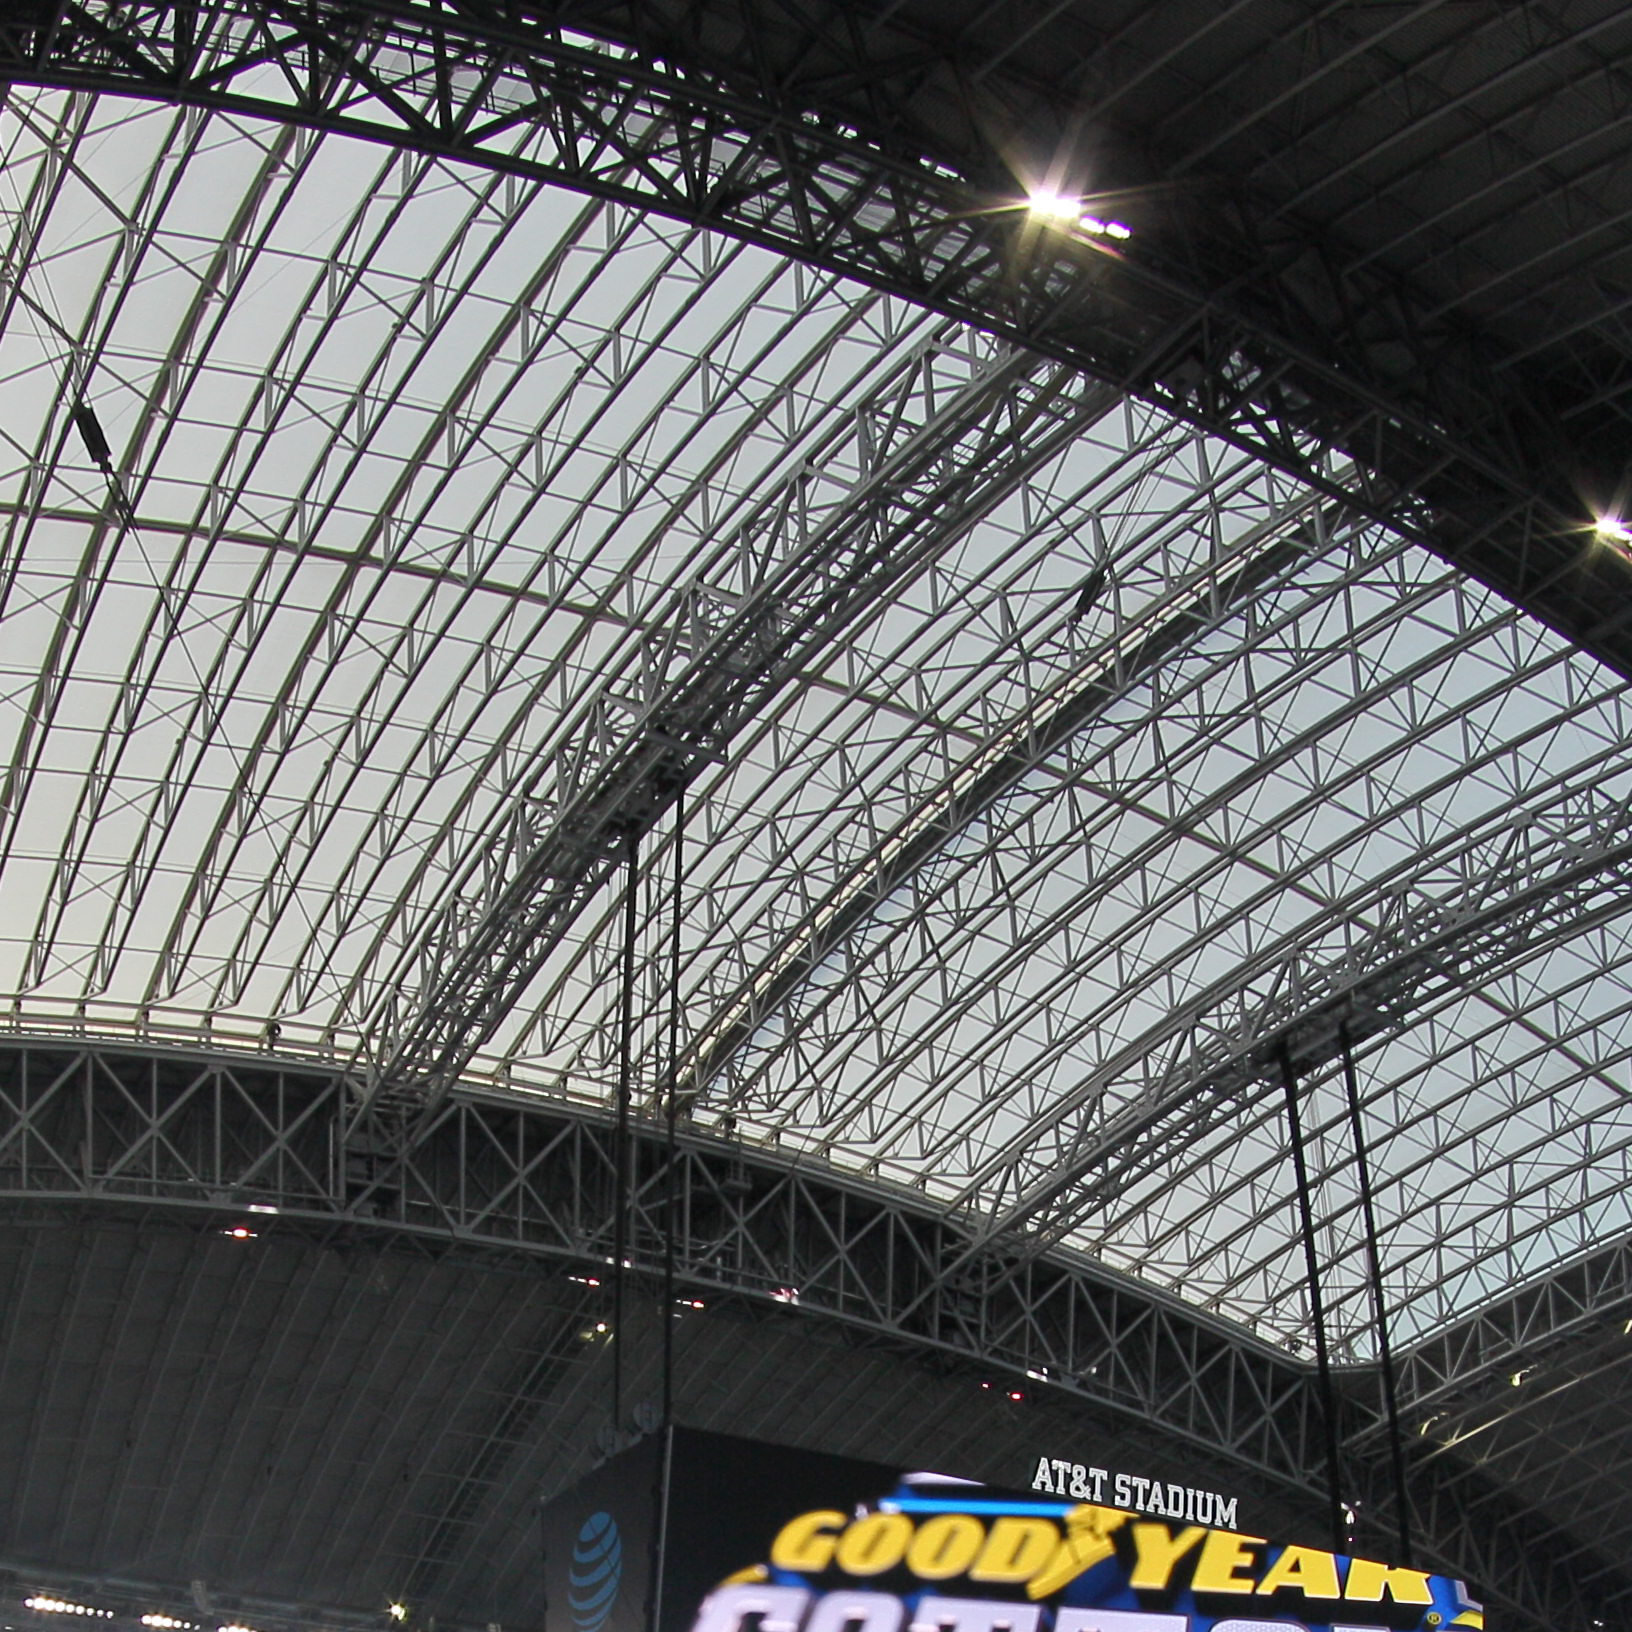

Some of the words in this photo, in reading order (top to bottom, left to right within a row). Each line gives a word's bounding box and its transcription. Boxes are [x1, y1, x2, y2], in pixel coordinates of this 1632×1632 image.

[1032, 1457, 1108, 1502] AT&T
[1114, 1473, 1238, 1530] STADIUM
[768, 1503, 1436, 1606] GOODYEAR
